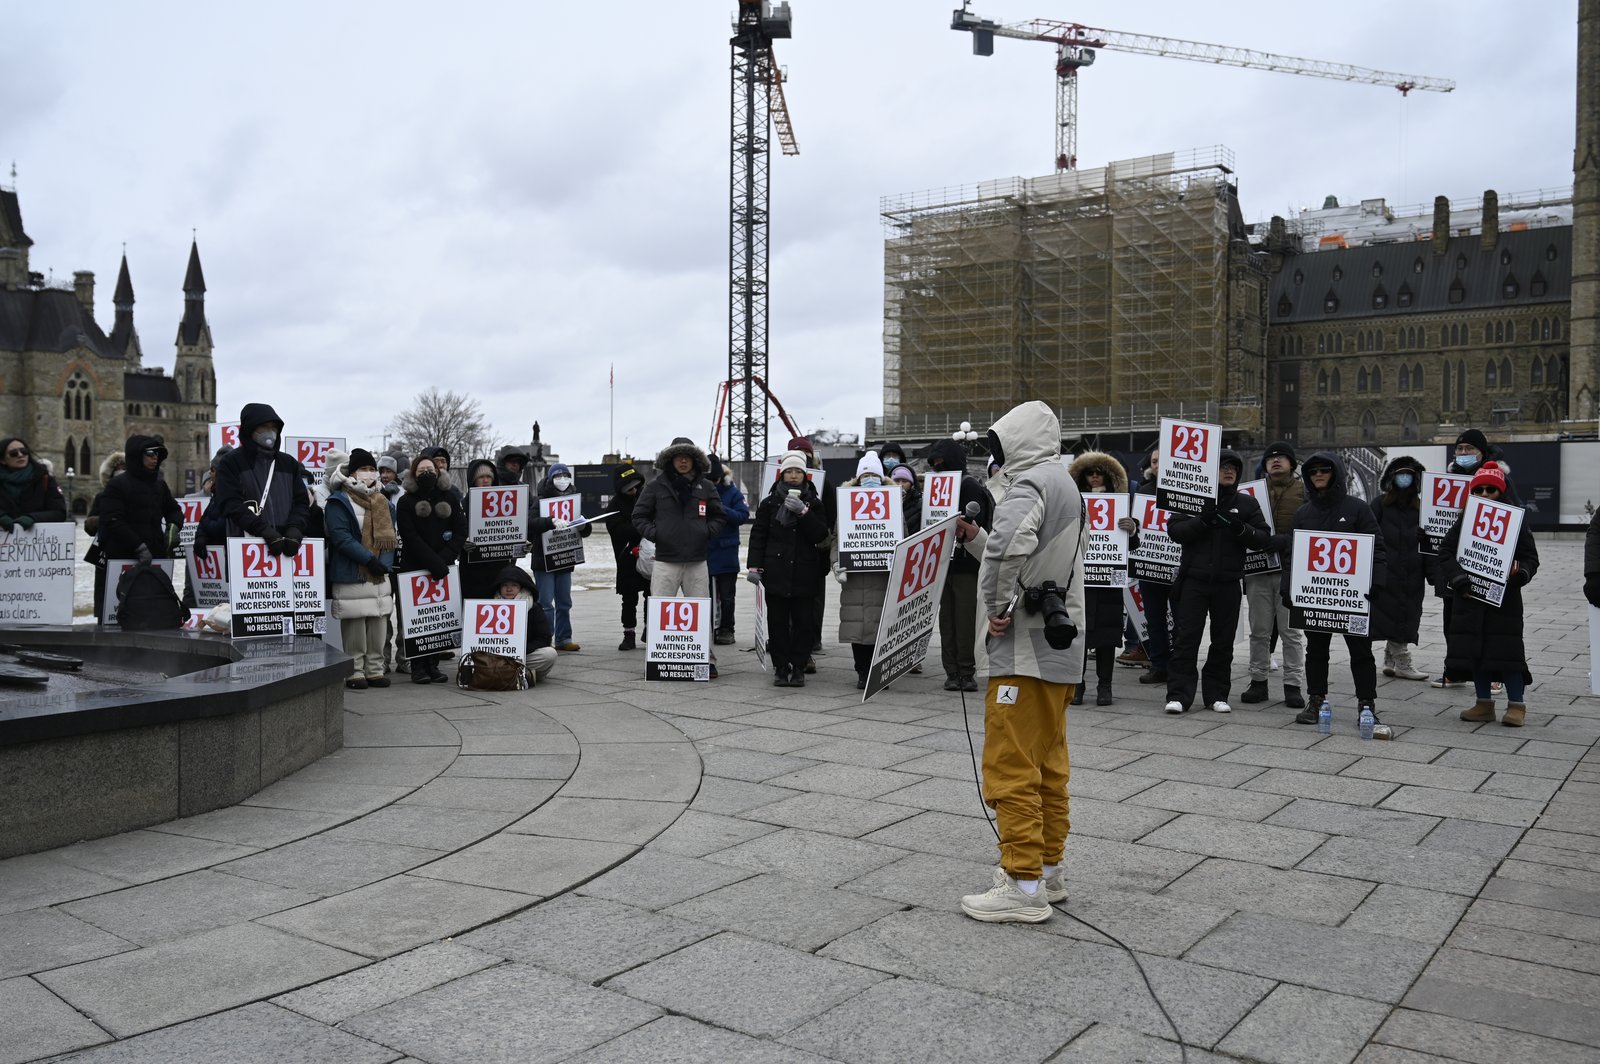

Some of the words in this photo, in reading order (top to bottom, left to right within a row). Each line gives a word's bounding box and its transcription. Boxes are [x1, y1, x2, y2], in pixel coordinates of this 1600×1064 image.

[226, 426, 240, 448] 3
[1174, 426, 1204, 460] 23
[302, 442, 328, 467] 25
[1173, 461, 1202, 472] MONTHS
[1166, 469, 1193, 481] WAITING
[1195, 475, 1208, 484] FOR
[932, 477, 950, 506] 34
[1161, 478, 1176, 487] IRCC
[1176, 482, 1212, 494] RESPONSE
[1438, 479, 1466, 508] 27
[486, 491, 513, 517] 36
[855, 492, 886, 519] 23
[1176, 494, 1204, 505] TIMELINES
[1178, 502, 1202, 512] RESULTS
[552, 501, 570, 522] 18
[1091, 499, 1109, 530] 3
[1436, 510, 1459, 518] MONTH
[1476, 505, 1507, 542] 55
[13, 528, 28, 545] des
[33, 528, 58, 544] délais
[557, 540, 579, 549] RESPONSE
[1167, 545, 1180, 554] FOR
[1472, 541, 1498, 556] MONTHS
[246, 544, 277, 577] 25
[1146, 551, 1180, 562] RESPONS
[1312, 538, 1352, 573] 36
[1464, 548, 1489, 563] WAITING
[1489, 557, 1503, 568] FOR
[198, 552, 216, 578] 19
[903, 533, 940, 597] 36
[1144, 563, 1174, 572] TIMELINES
[1244, 561, 1266, 570] ESULTS
[1471, 561, 1504, 579] RESPONSE
[4, 567, 21, 578] sont
[24, 569, 35, 577] en
[38, 567, 73, 580] suspens.
[1146, 570, 1171, 580] RESULTS
[1468, 574, 1491, 588] TIMELINE
[248, 581, 278, 589] MONTHS
[1311, 576, 1349, 587] MONTHS
[240, 591, 270, 600] WAITING
[416, 576, 445, 605] 23
[1302, 586, 1338, 596] WAITING
[1341, 589, 1358, 598] FOR
[1471, 585, 1489, 596] ESULTS
[253, 601, 290, 609] RESPONSE
[897, 591, 929, 618] MONTHS
[1296, 595, 1314, 604] IRCC
[1316, 598, 1363, 609] RESPONSE
[12, 604, 40, 619] clairs.
[418, 605, 446, 616] MONTHS
[665, 603, 693, 631] 19
[1315, 612, 1349, 621] TIMELINE
[411, 614, 440, 626] WAITING
[442, 612, 455, 620] FOR
[479, 605, 510, 634] 28
[886, 610, 918, 638] WAITING
[918, 602, 933, 618] FOR
[1318, 620, 1349, 629] RESULTS
[408, 625, 423, 635] IRCC
[424, 619, 459, 632] RESPONSE
[878, 636, 895, 658] IRCC
[895, 613, 933, 648] RESPONSE
[428, 639, 452, 650] RESULTS
[880, 658, 890, 672] NO
[890, 642, 918, 667] TIMELINE
[880, 670, 890, 683] NO
[890, 654, 915, 678] RESULTS
